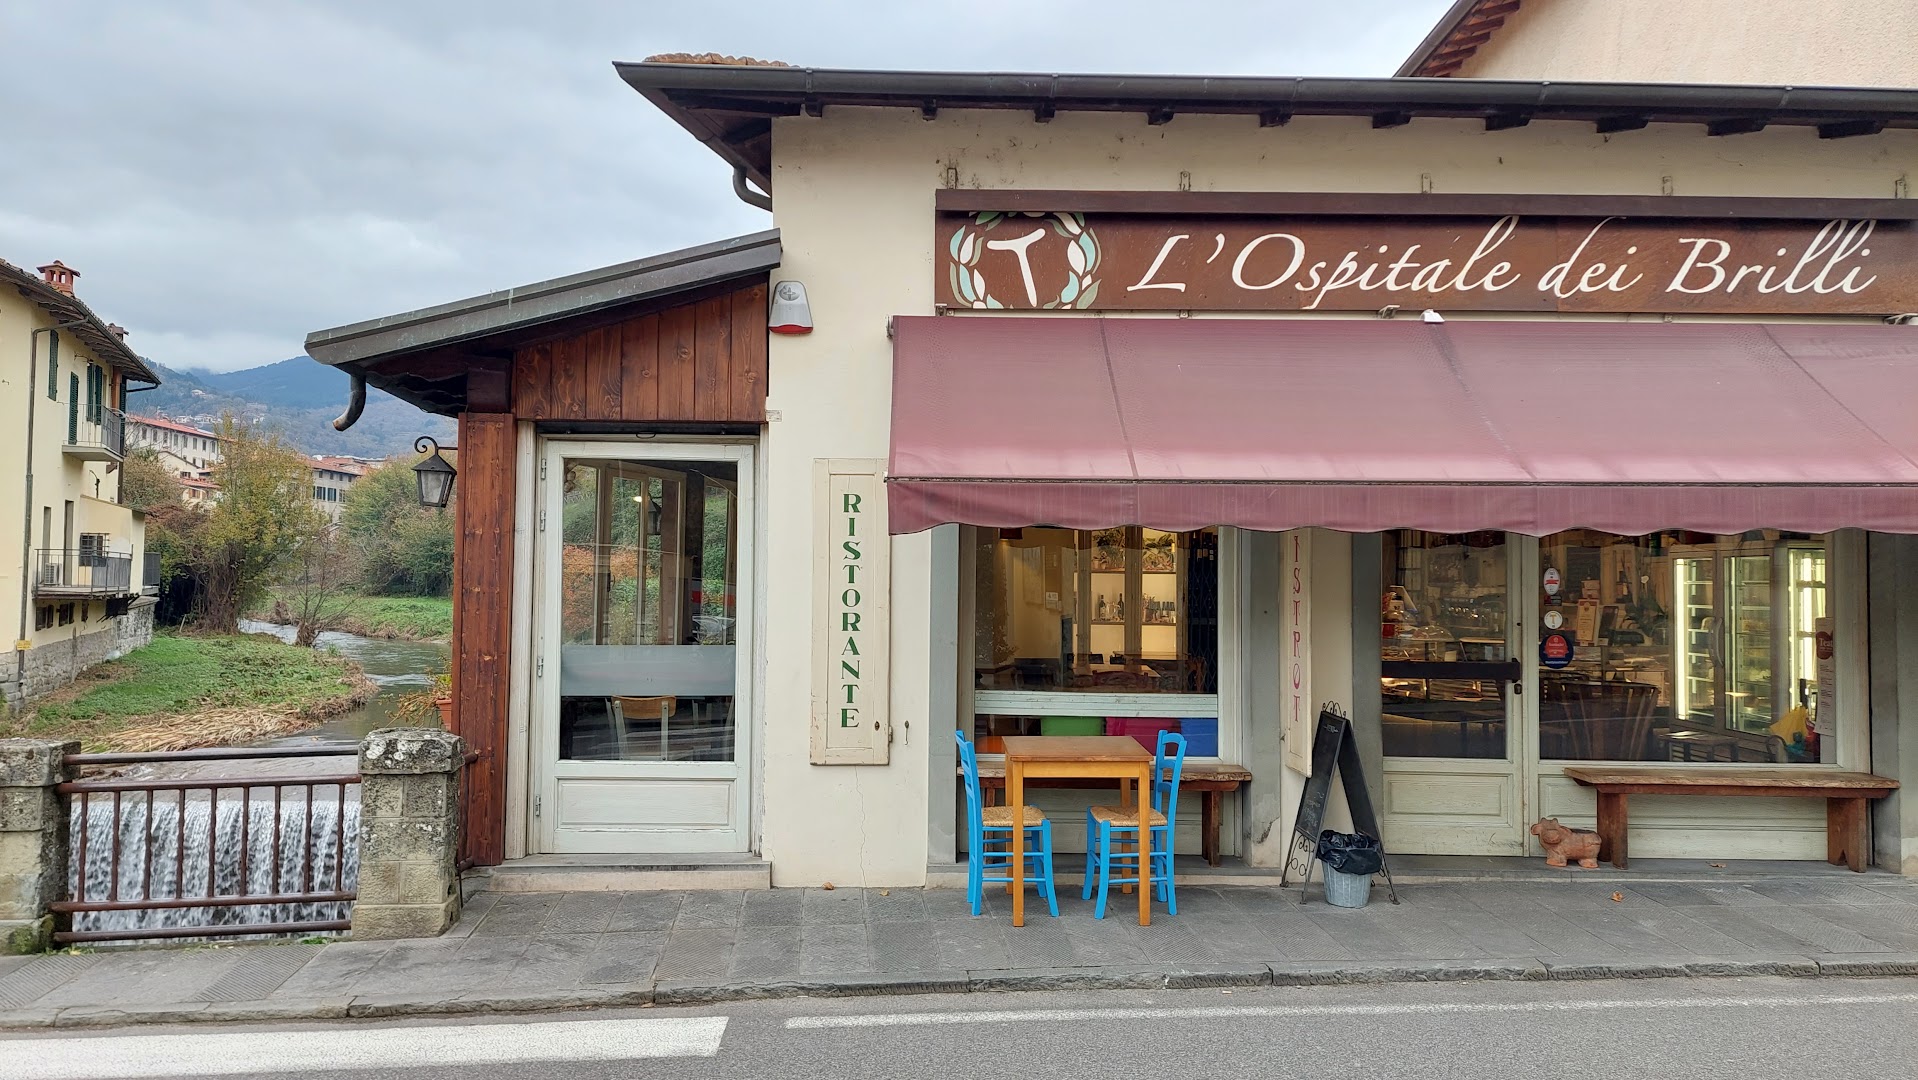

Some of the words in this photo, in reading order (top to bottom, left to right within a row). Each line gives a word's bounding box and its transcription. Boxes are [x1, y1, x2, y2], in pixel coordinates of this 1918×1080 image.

[1126, 215, 1521, 309] L'Ospitale
[1537, 216, 1644, 299] dei
[1665, 219, 1877, 294] Brilli
[840, 493, 862, 729] RISTORANTE
[1292, 535, 1301, 722] ISTROT
